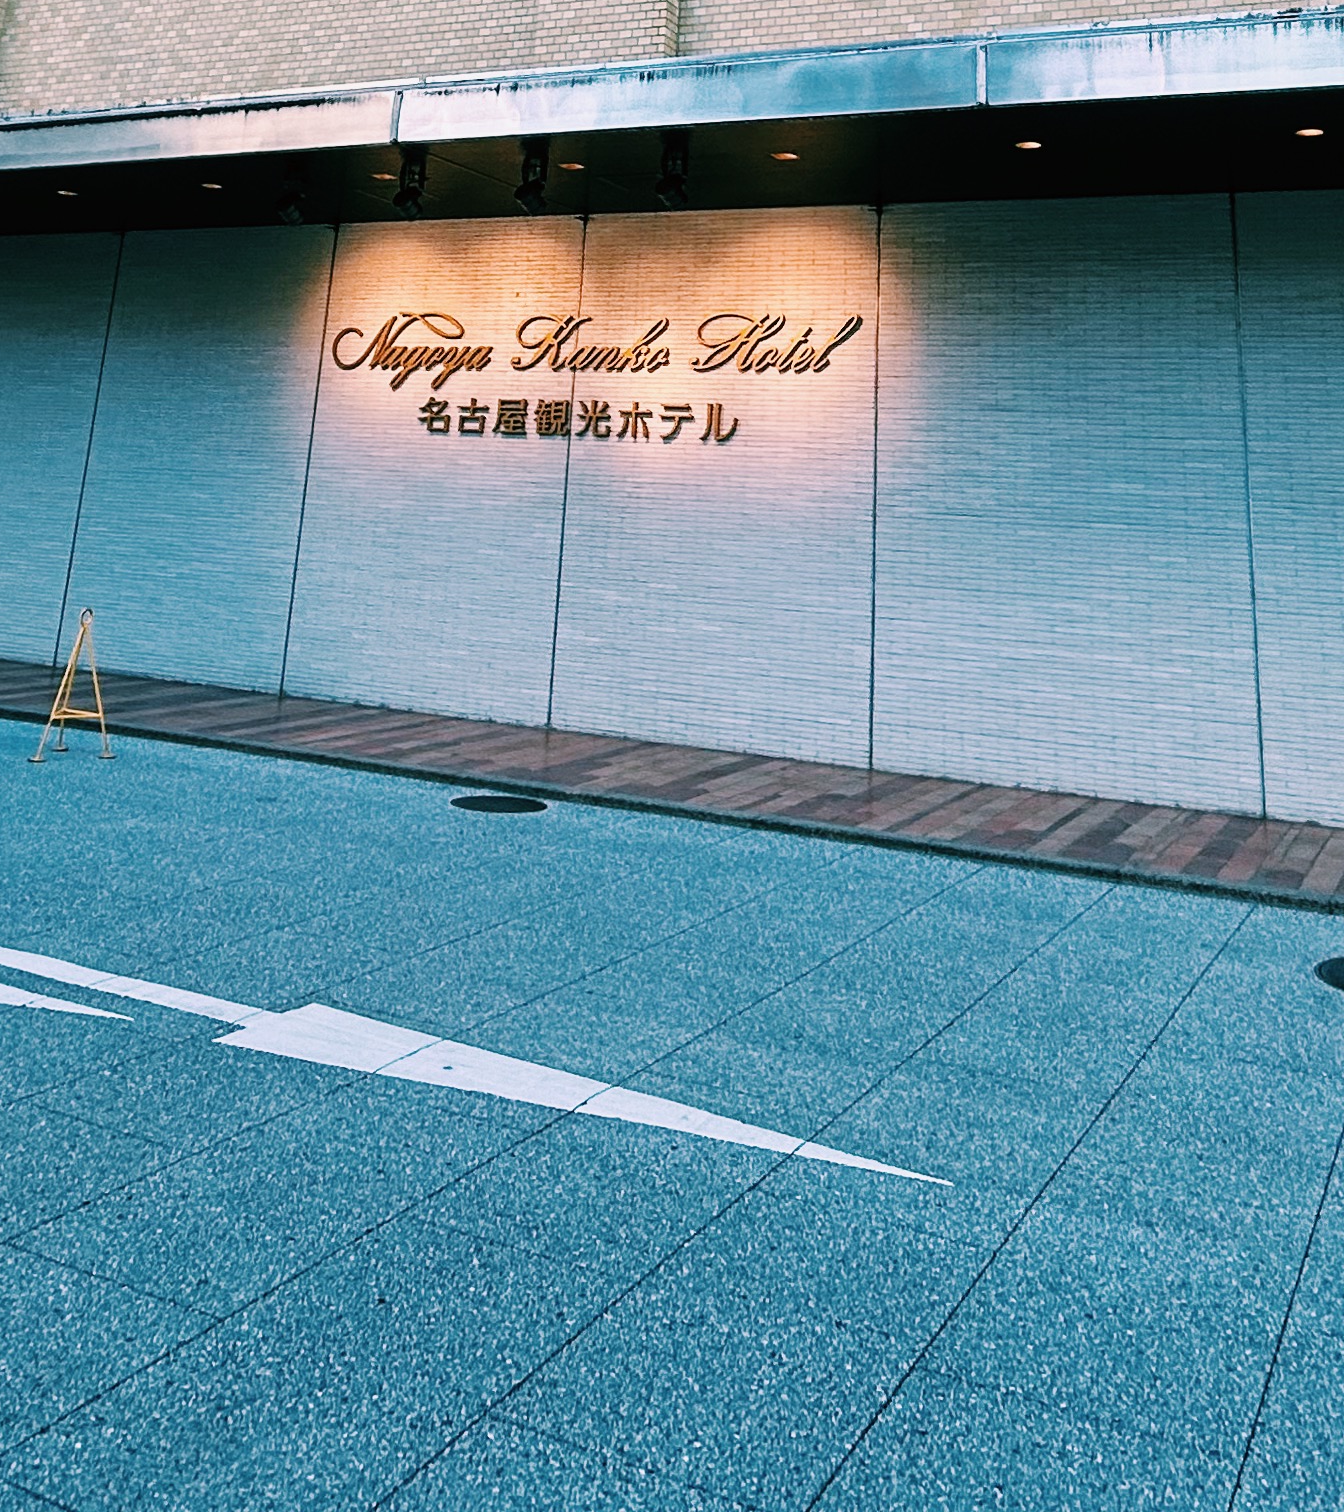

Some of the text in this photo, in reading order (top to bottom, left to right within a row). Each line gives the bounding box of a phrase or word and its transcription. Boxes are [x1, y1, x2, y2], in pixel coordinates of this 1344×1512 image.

[332, 311, 863, 391] Nagoya Kanko Hotel
[417, 396, 740, 443] 名古屋観光ホテル
